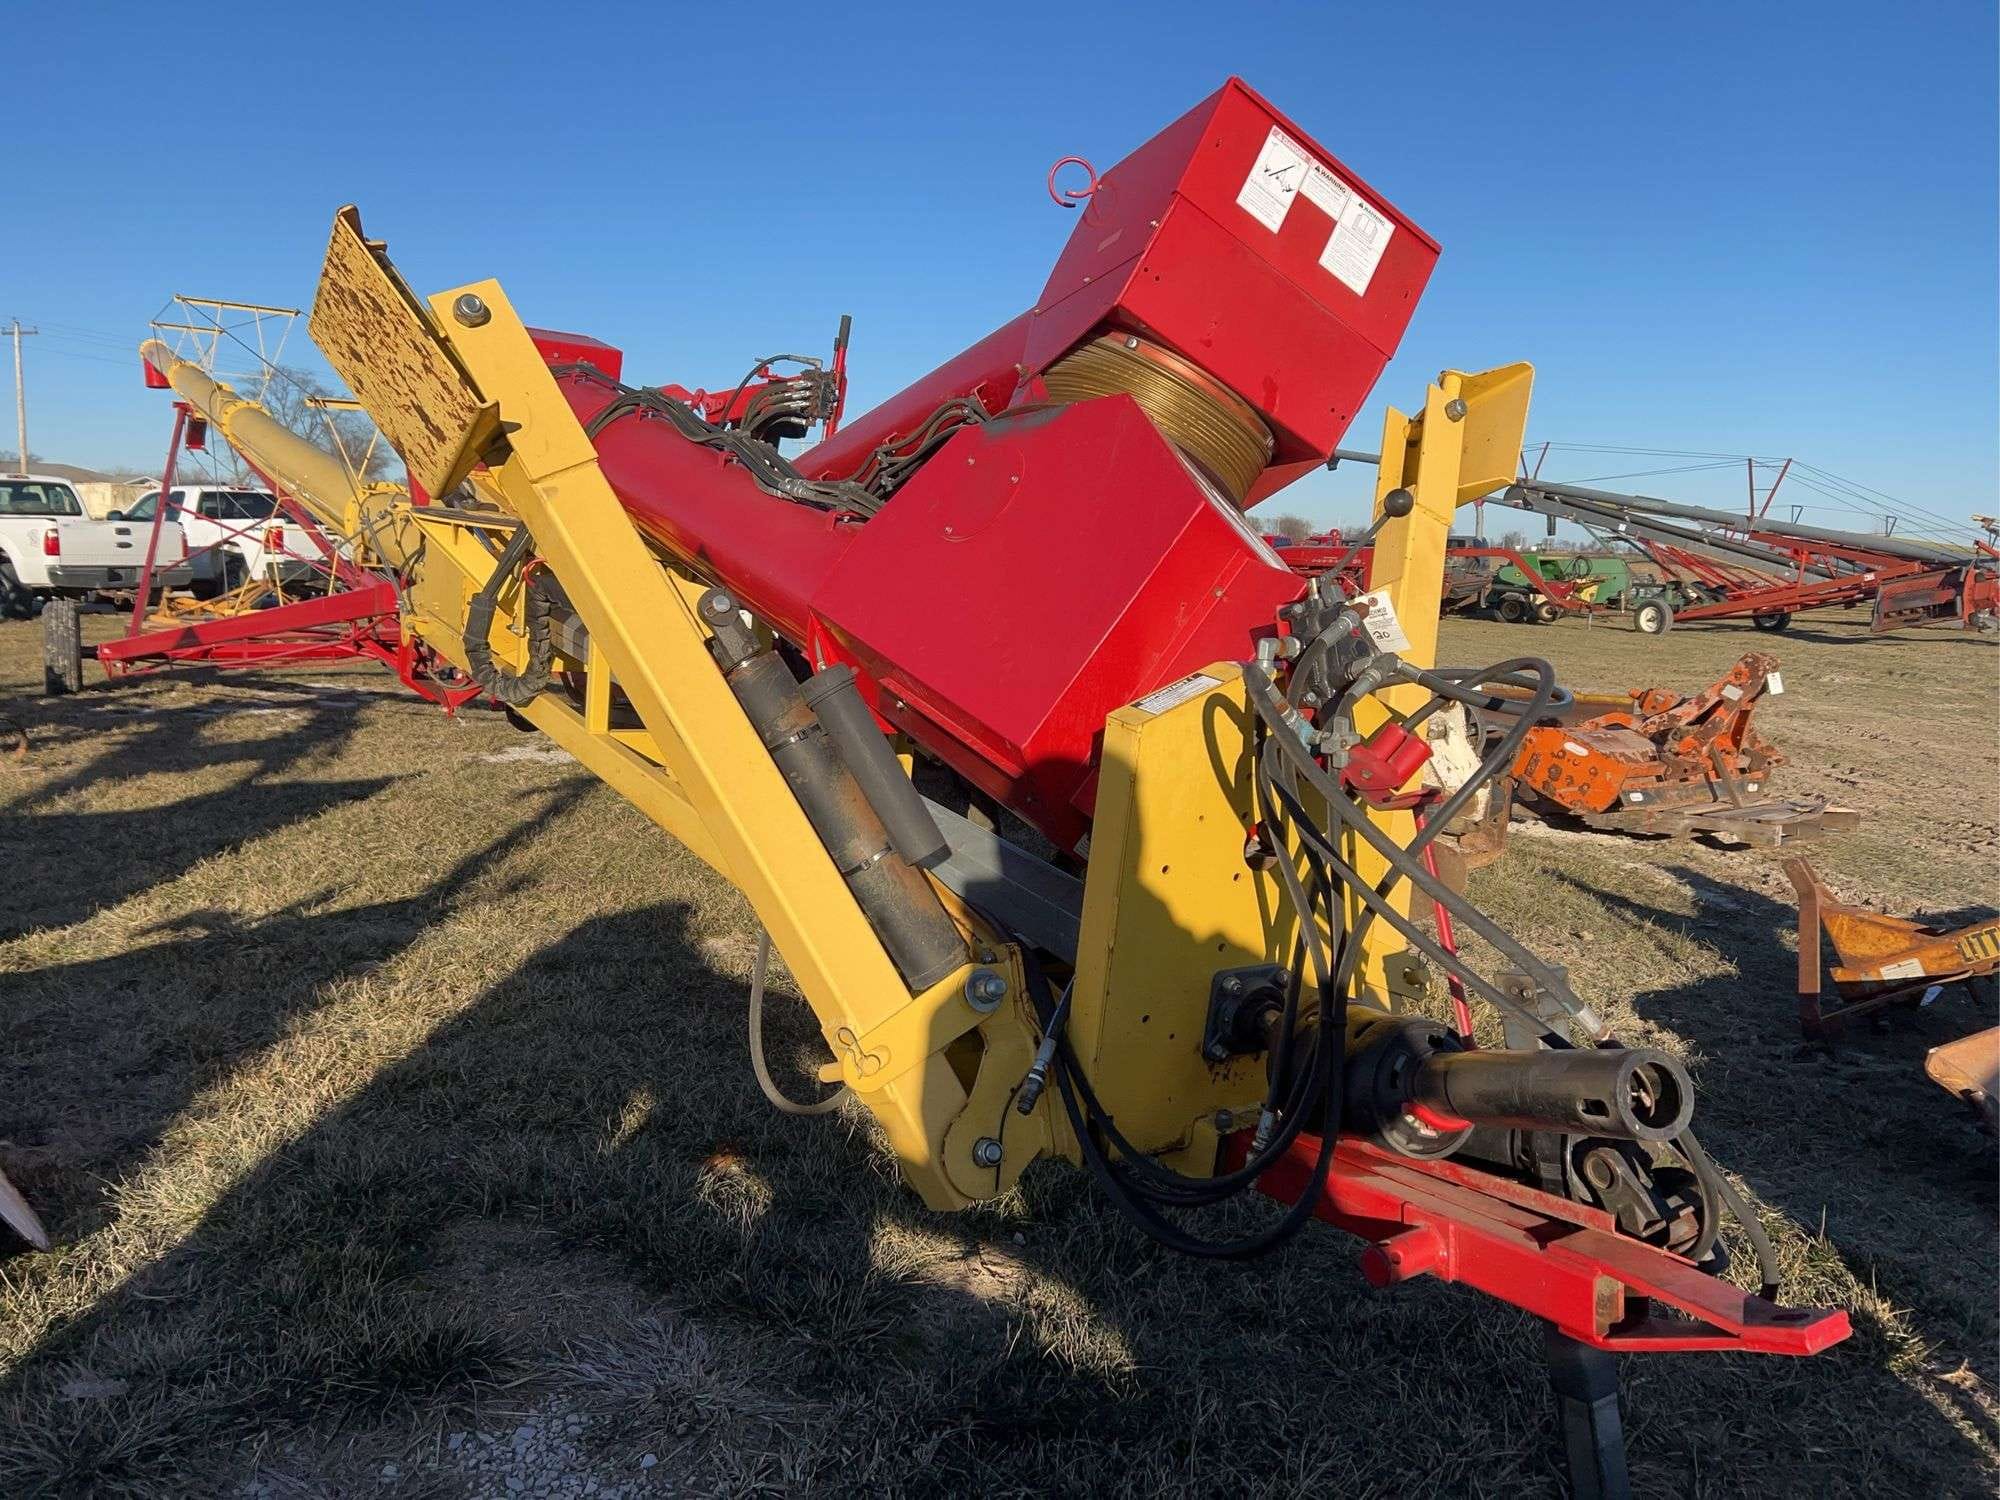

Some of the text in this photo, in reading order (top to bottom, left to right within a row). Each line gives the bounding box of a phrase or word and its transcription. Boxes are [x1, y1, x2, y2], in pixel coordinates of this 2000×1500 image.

[1281, 137, 1308, 160] DANGER
[1319, 169, 1347, 195] WARNING
[1363, 206, 1386, 227] WARNING
